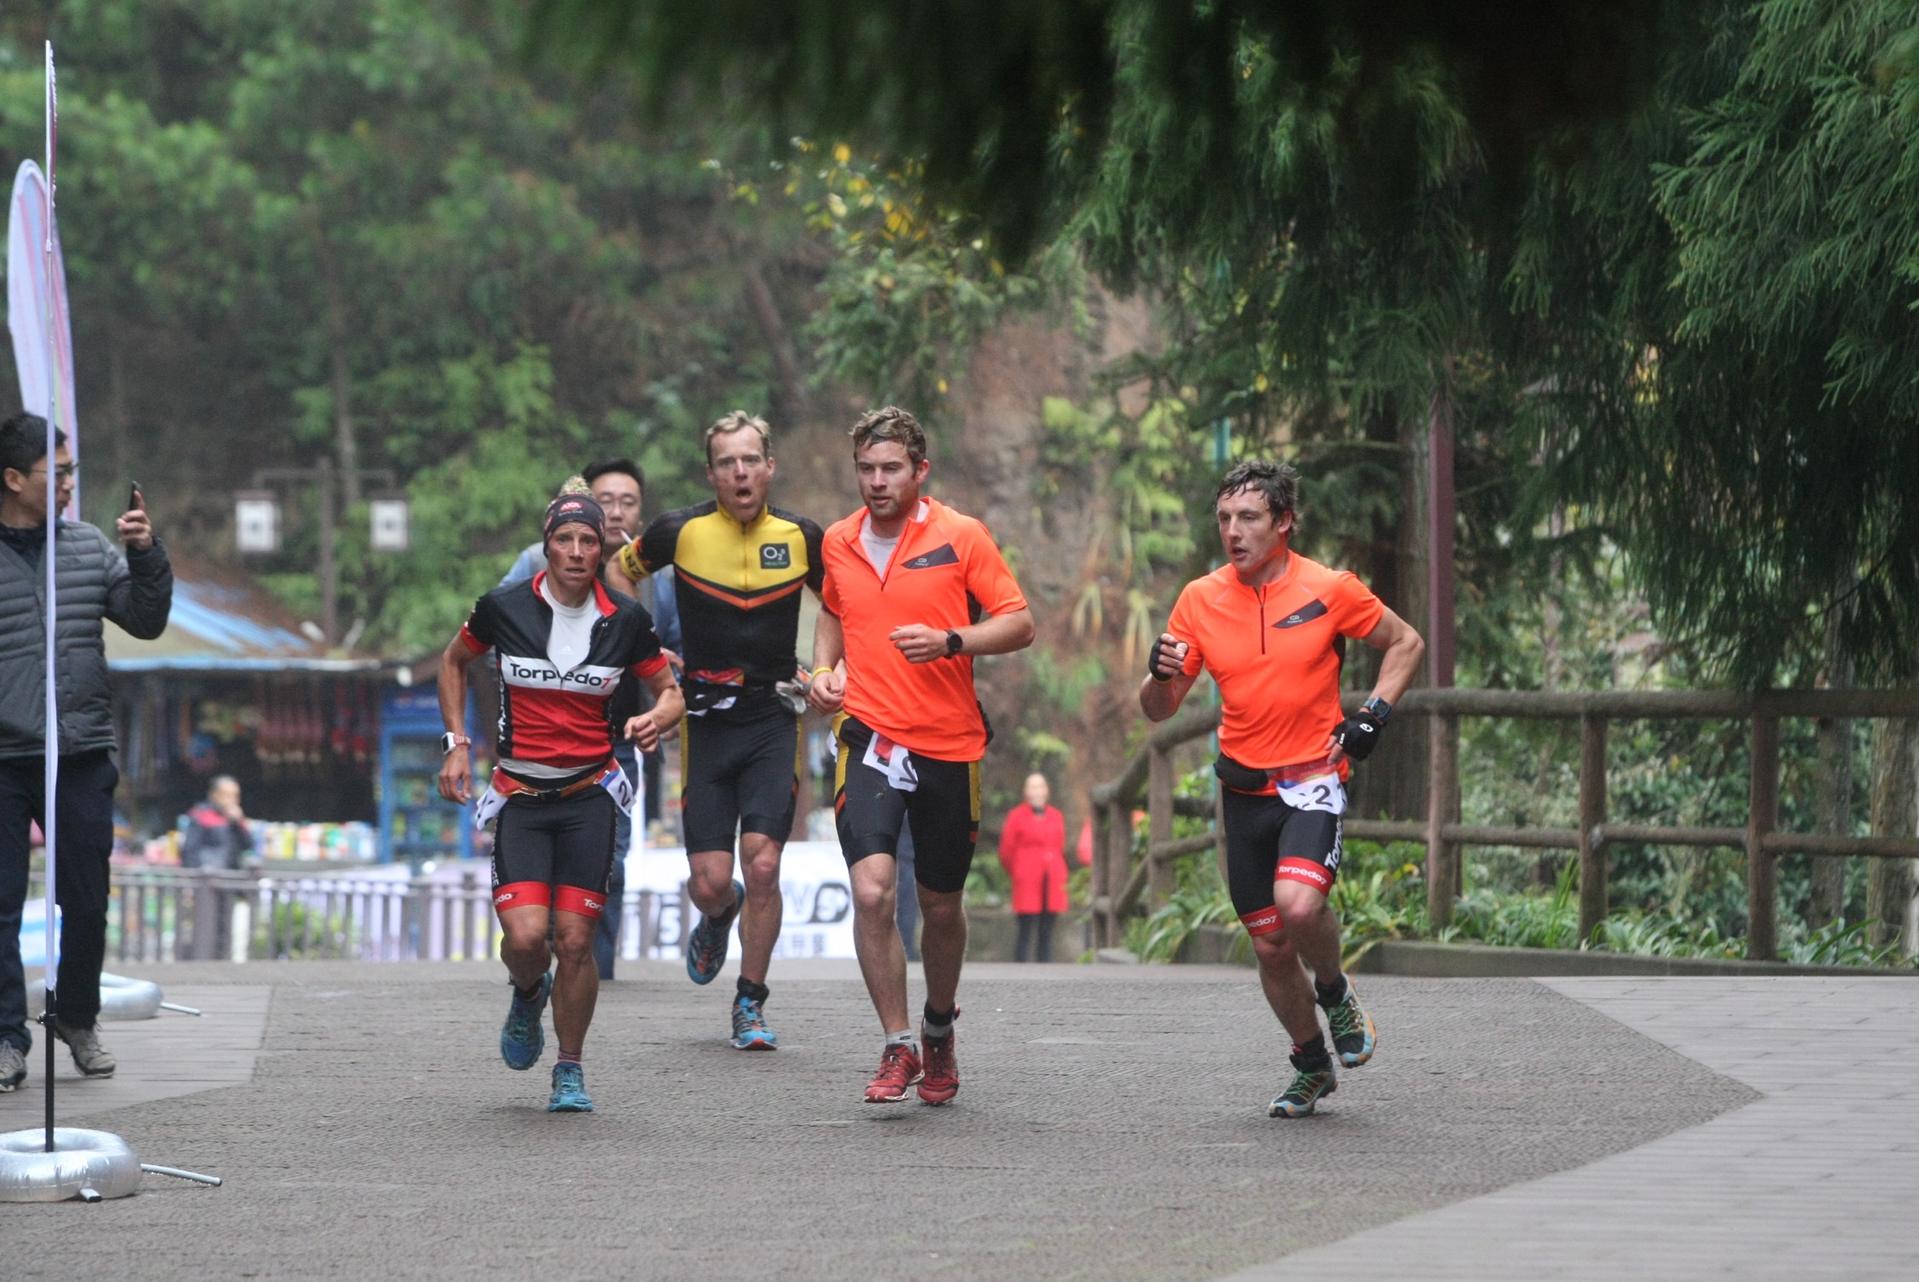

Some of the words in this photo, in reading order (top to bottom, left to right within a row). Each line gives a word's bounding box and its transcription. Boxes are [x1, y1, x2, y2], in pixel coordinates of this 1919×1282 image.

[510, 663, 612, 689] Torpedo7
[619, 781, 630, 808] 2
[1312, 784, 1333, 807] 2
